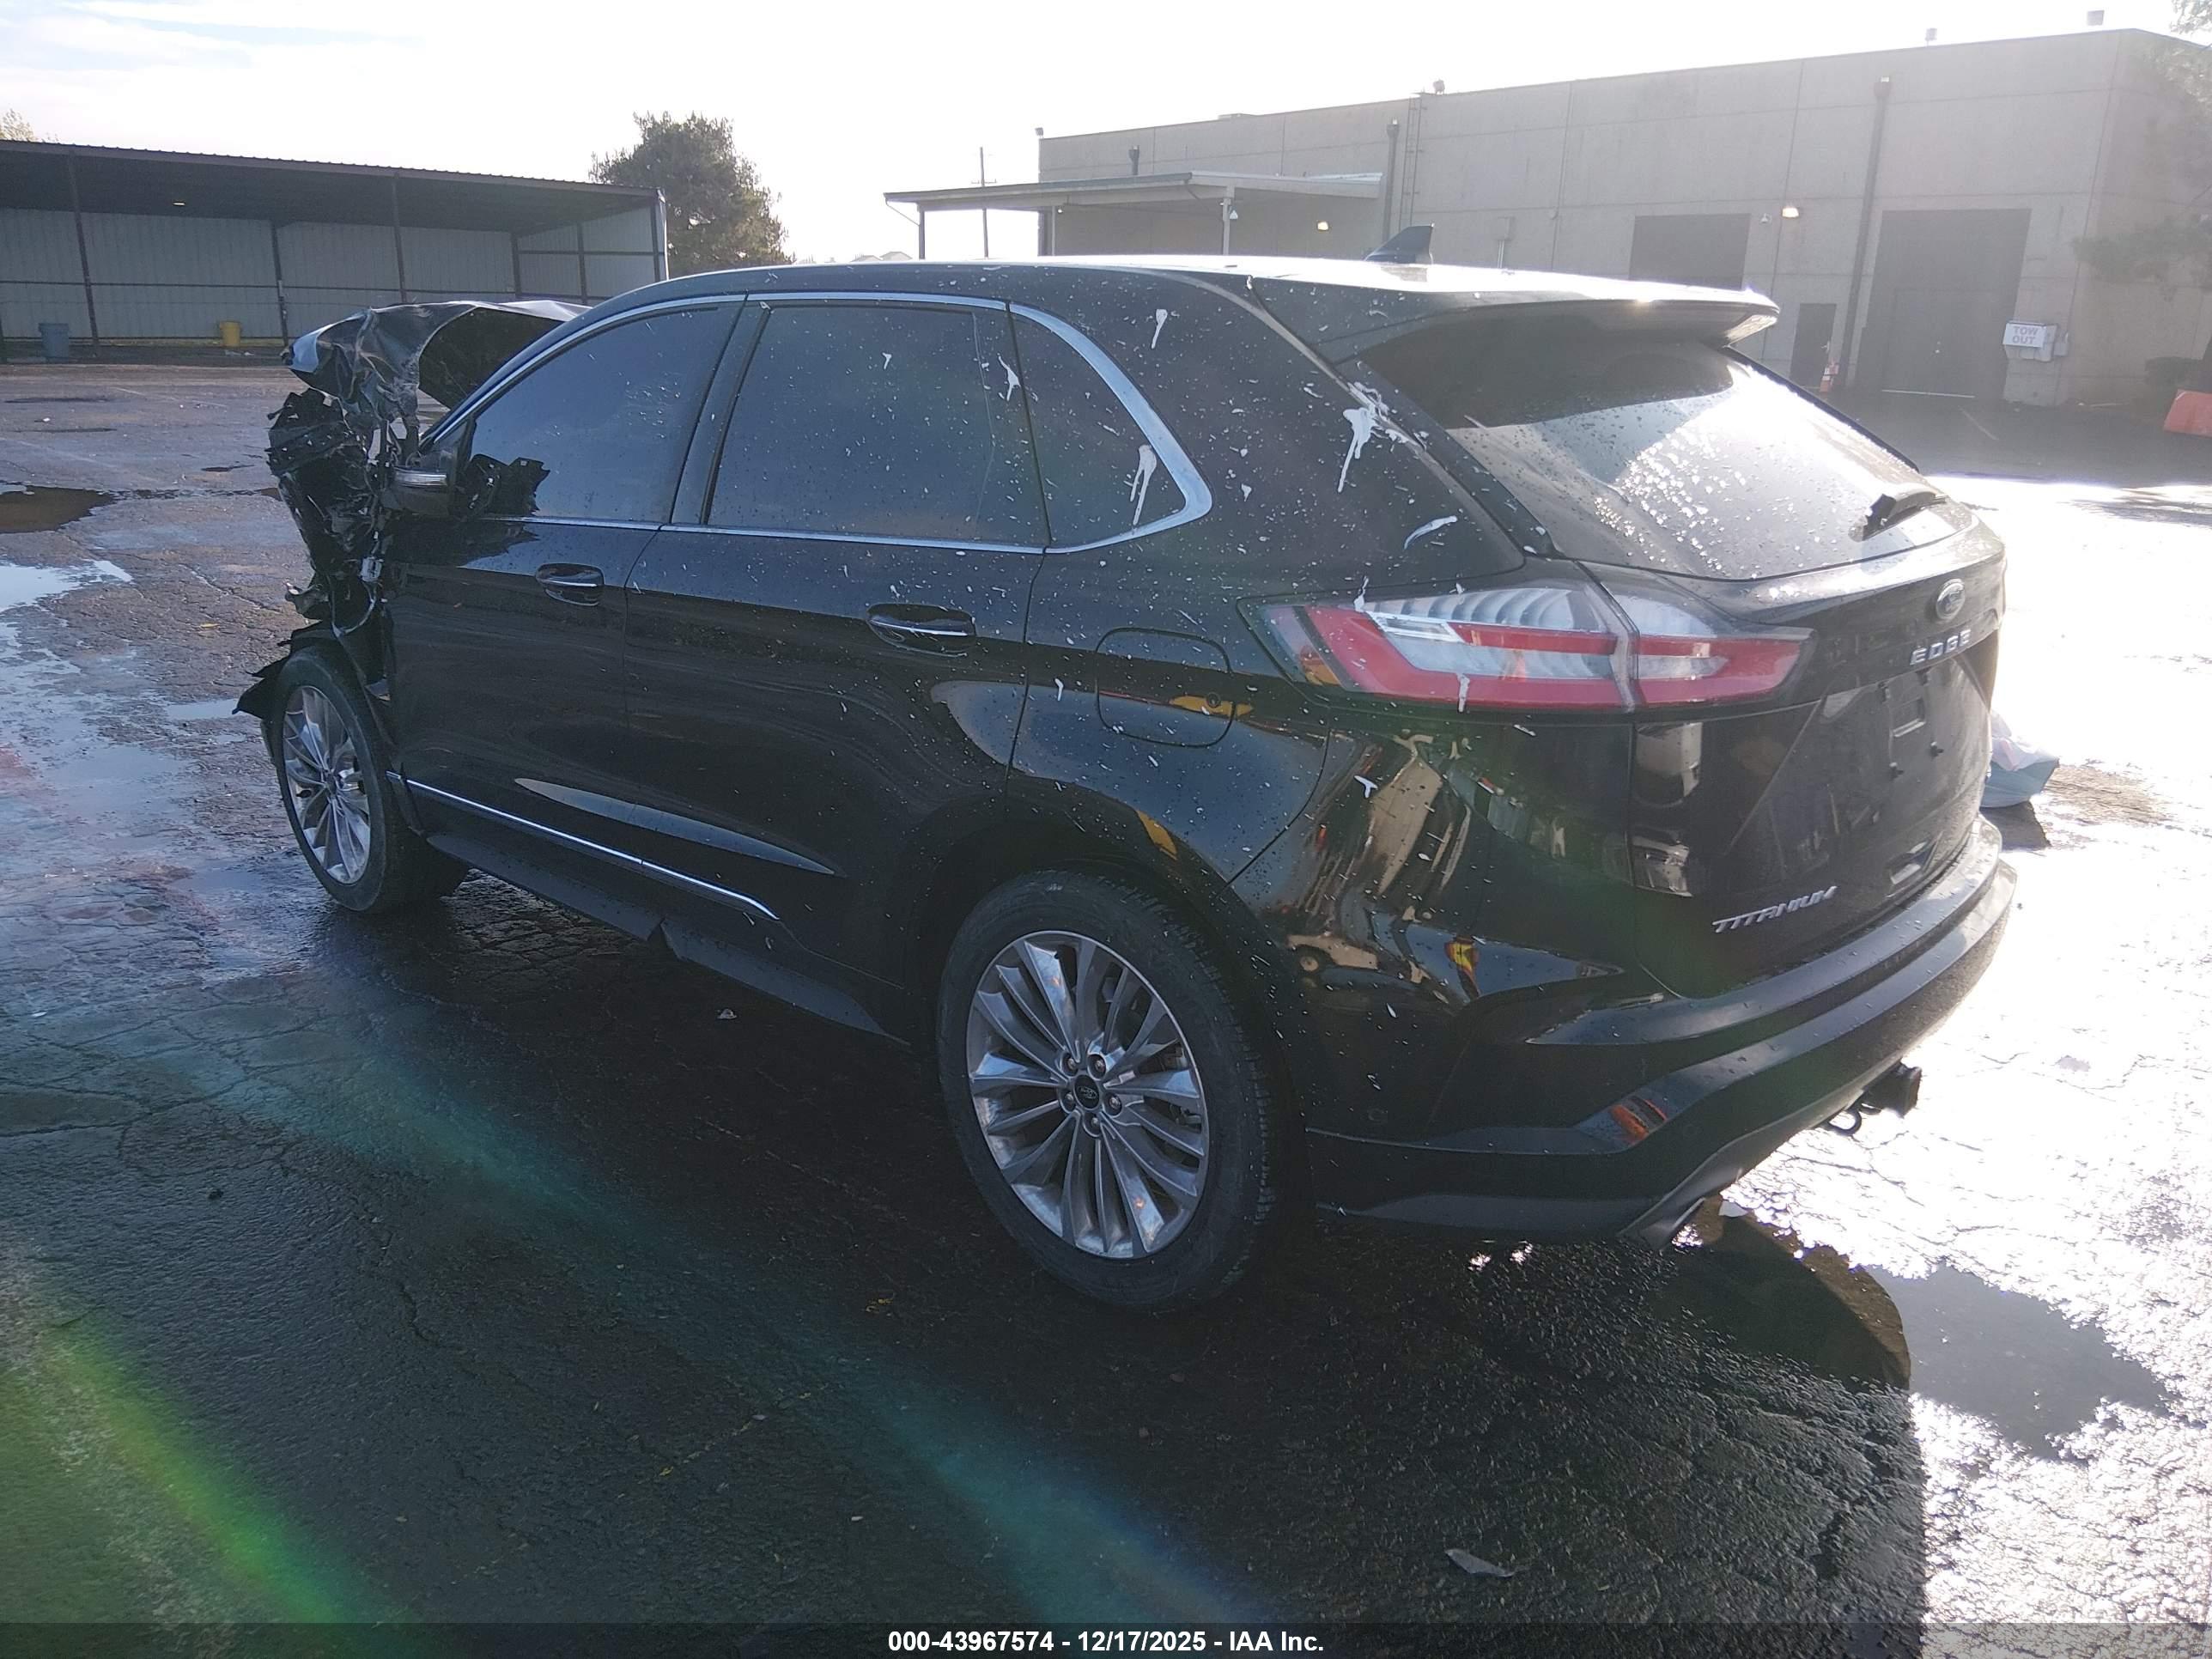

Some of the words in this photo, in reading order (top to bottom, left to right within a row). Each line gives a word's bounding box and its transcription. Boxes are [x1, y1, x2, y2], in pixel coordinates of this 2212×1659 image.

[2012, 335, 2035, 344] OUT
[2013, 326, 2040, 336] TOW
[1909, 629, 1972, 665] EDGE
[1711, 885, 1838, 933] TITANIUM
